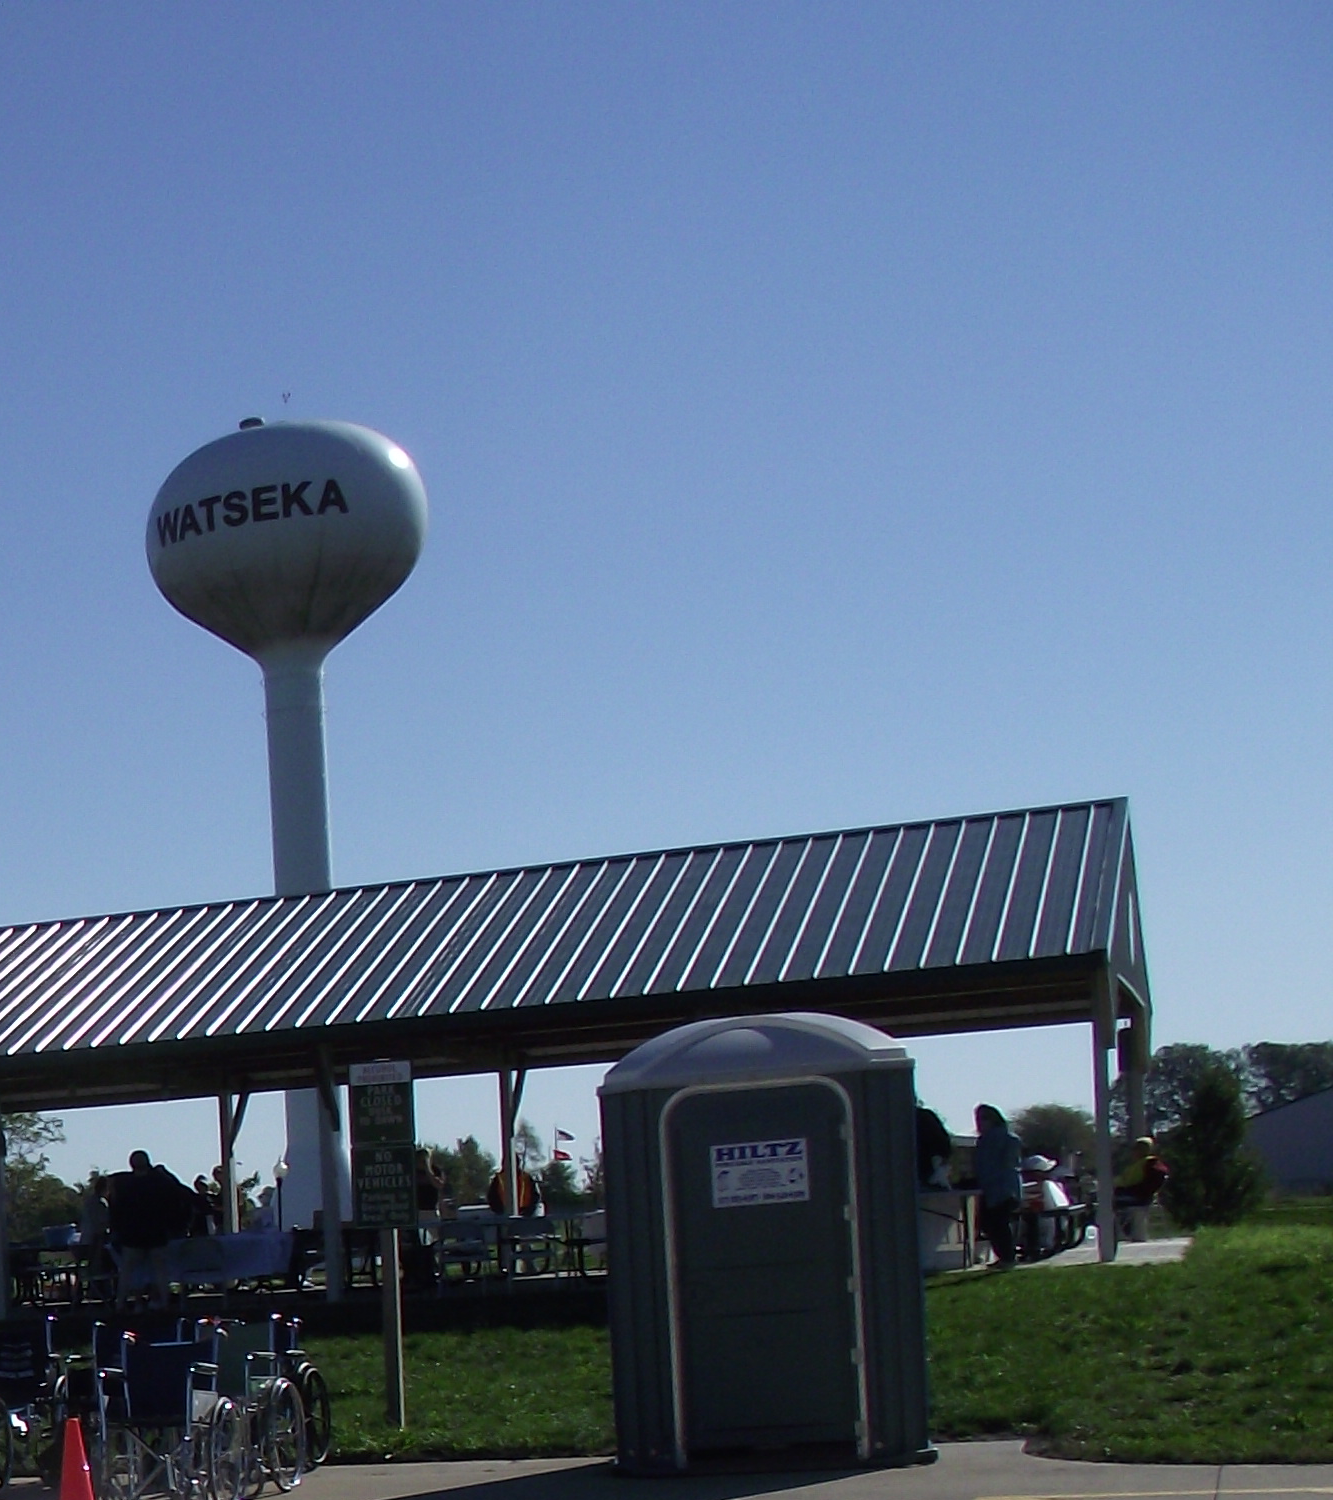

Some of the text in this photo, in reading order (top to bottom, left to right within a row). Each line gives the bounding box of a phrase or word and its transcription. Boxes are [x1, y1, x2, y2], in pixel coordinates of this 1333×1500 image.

[156, 478, 349, 547] WATSEKA
[360, 1094, 402, 1107] CLOSED
[375, 1151, 392, 1162] NO
[715, 1141, 802, 1162] HILTZ
[365, 1163, 404, 1176] MOTOR
[357, 1175, 411, 1190] VEHICLES
